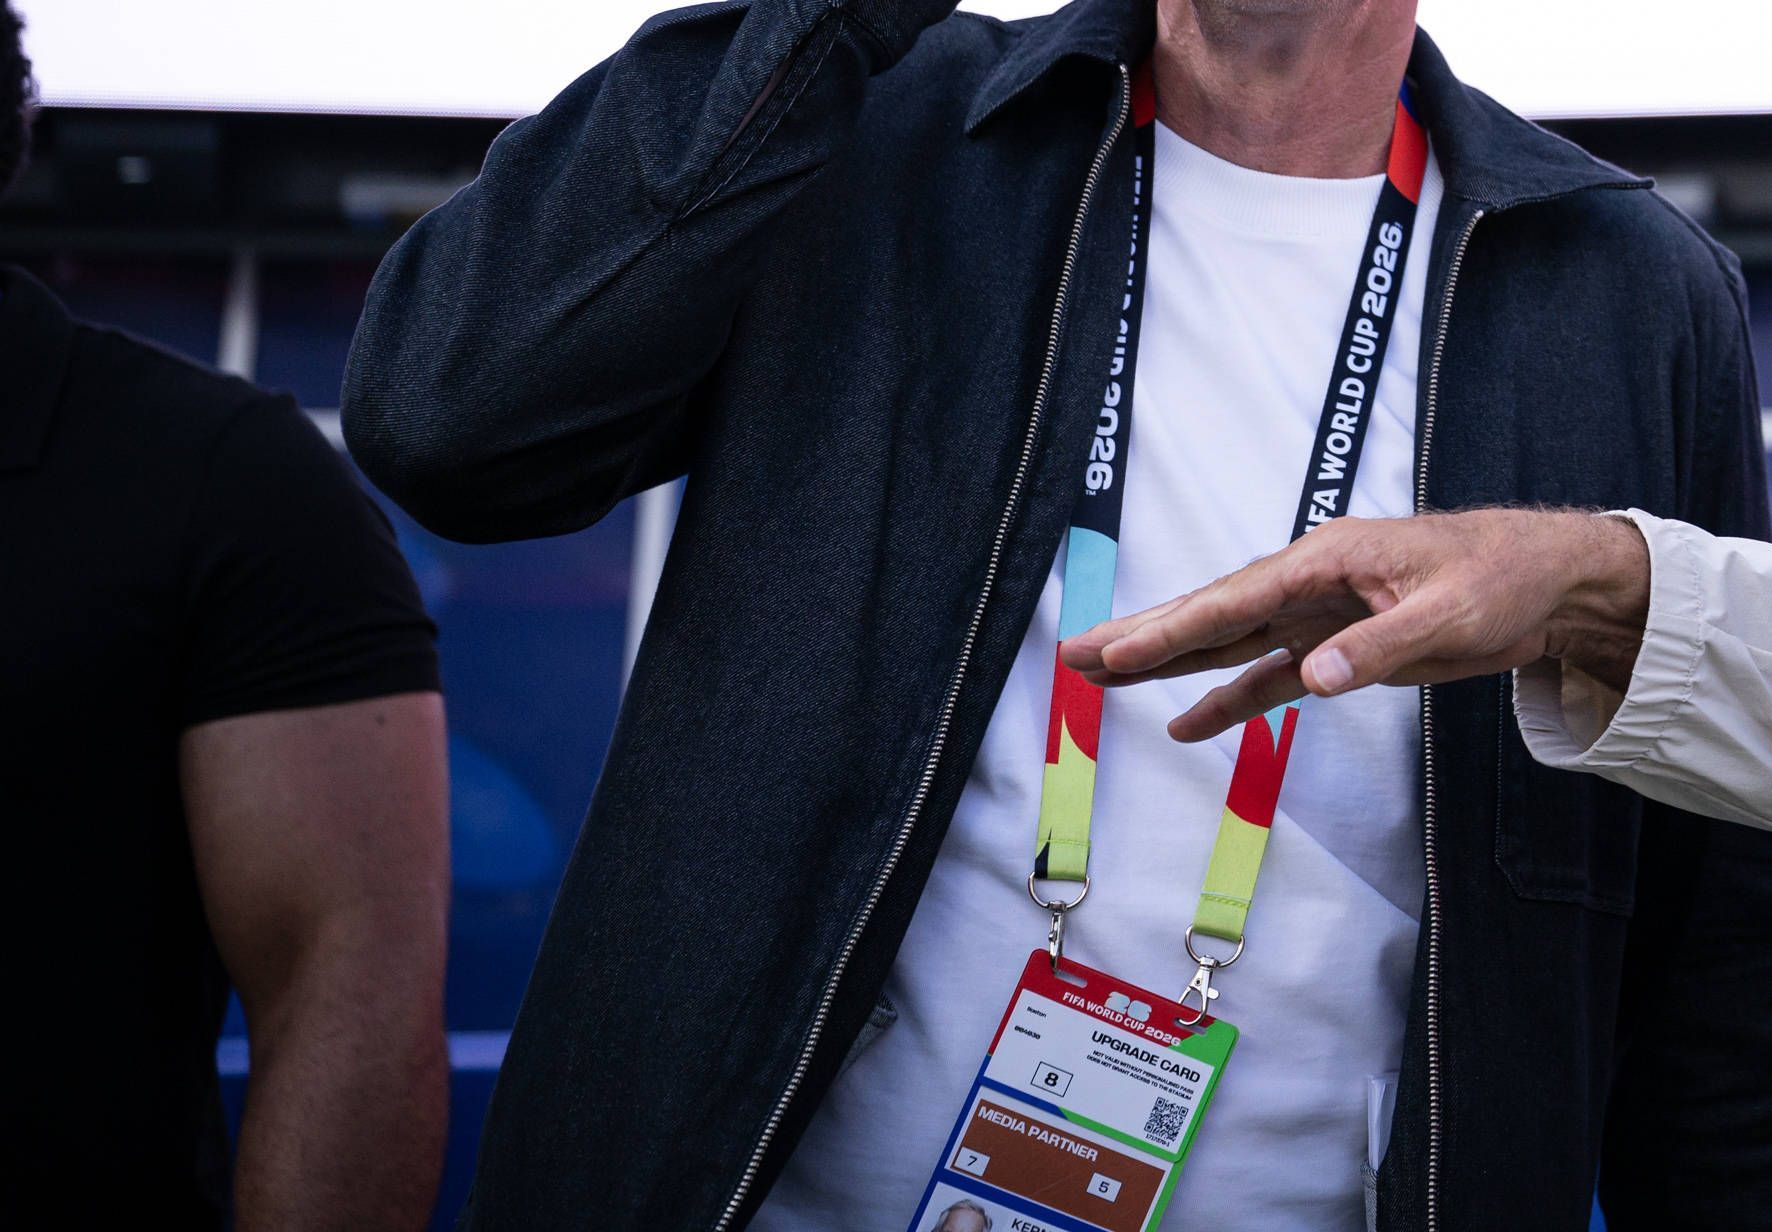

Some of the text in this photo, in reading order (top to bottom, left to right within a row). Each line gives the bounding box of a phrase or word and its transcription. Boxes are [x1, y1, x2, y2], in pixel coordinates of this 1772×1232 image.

[1362, 223, 1402, 318] 2026
[1346, 319, 1379, 374] CUP
[1318, 377, 1366, 482] WORLD
[1063, 992, 1181, 1046] FIFA WORLD CUP 2026
[1044, 1072, 1060, 1087] 8
[1093, 1031, 1200, 1082] UPGRADE CARD
[979, 1106, 1098, 1161] MEDIA PARTNER
[968, 1155, 978, 1167] 7
[1098, 1181, 1109, 1193] 5
